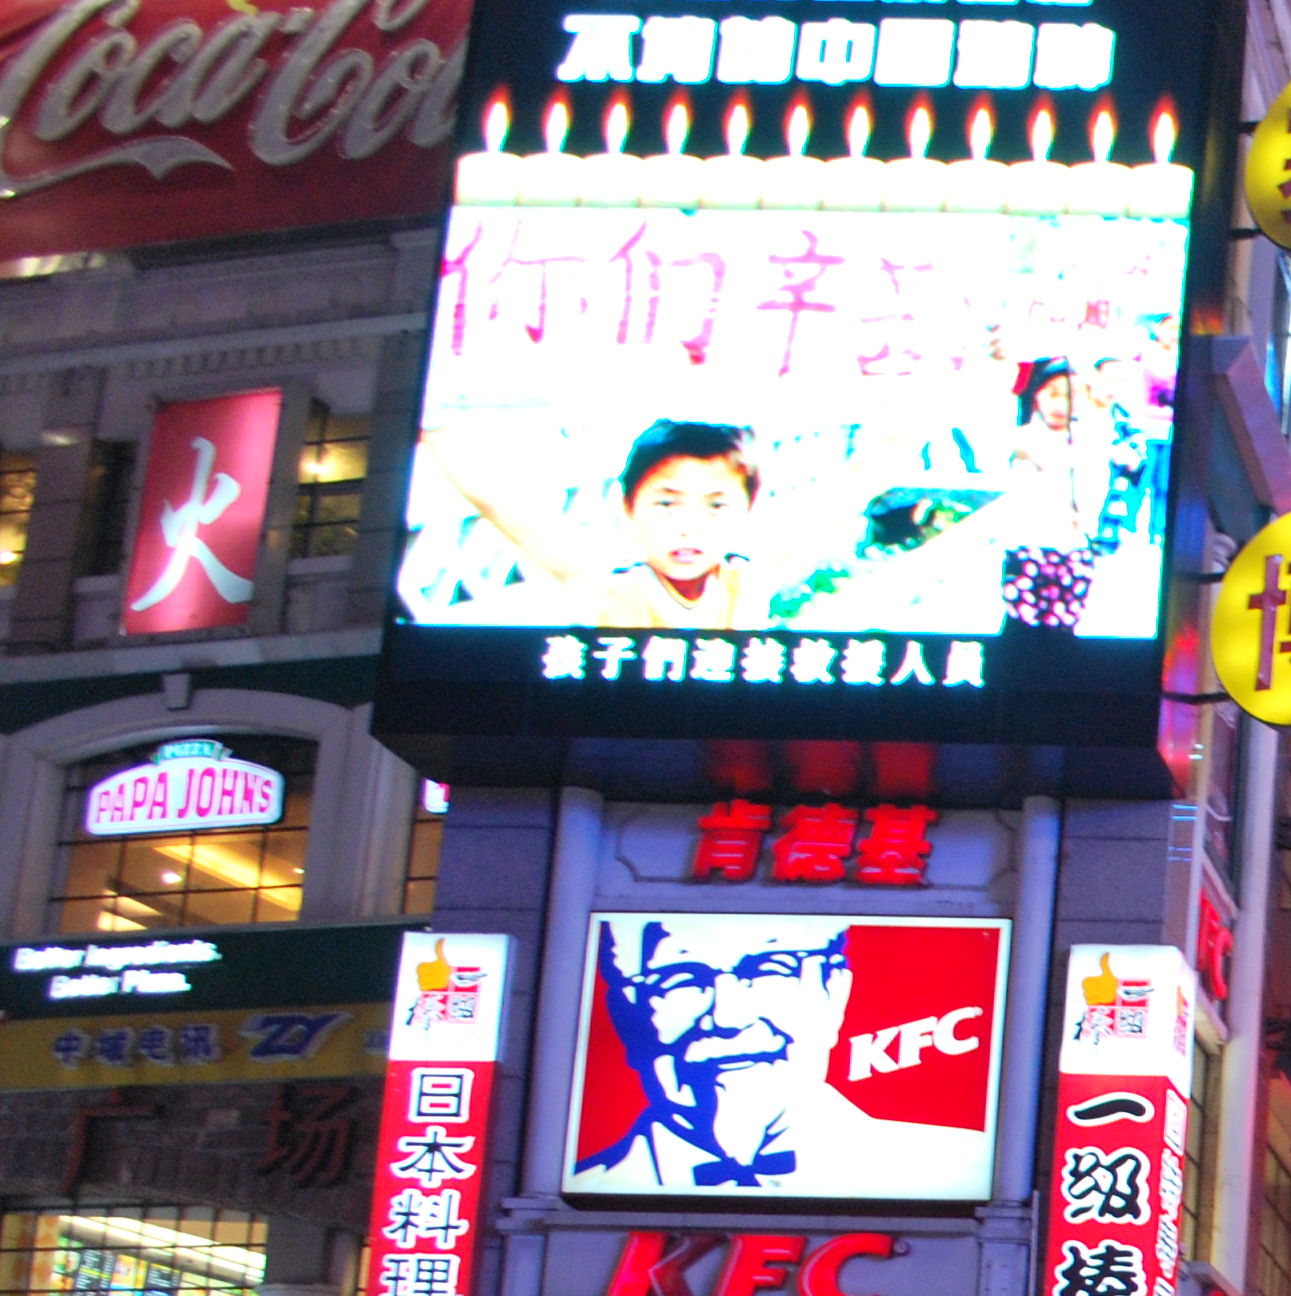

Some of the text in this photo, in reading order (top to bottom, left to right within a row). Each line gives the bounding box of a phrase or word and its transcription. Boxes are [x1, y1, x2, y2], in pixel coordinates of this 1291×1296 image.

[130, 436, 253, 612] 火
[94, 774, 169, 824] PAPA
[692, 801, 937, 885] 肯德基
[847, 1005, 984, 1083] KFC
